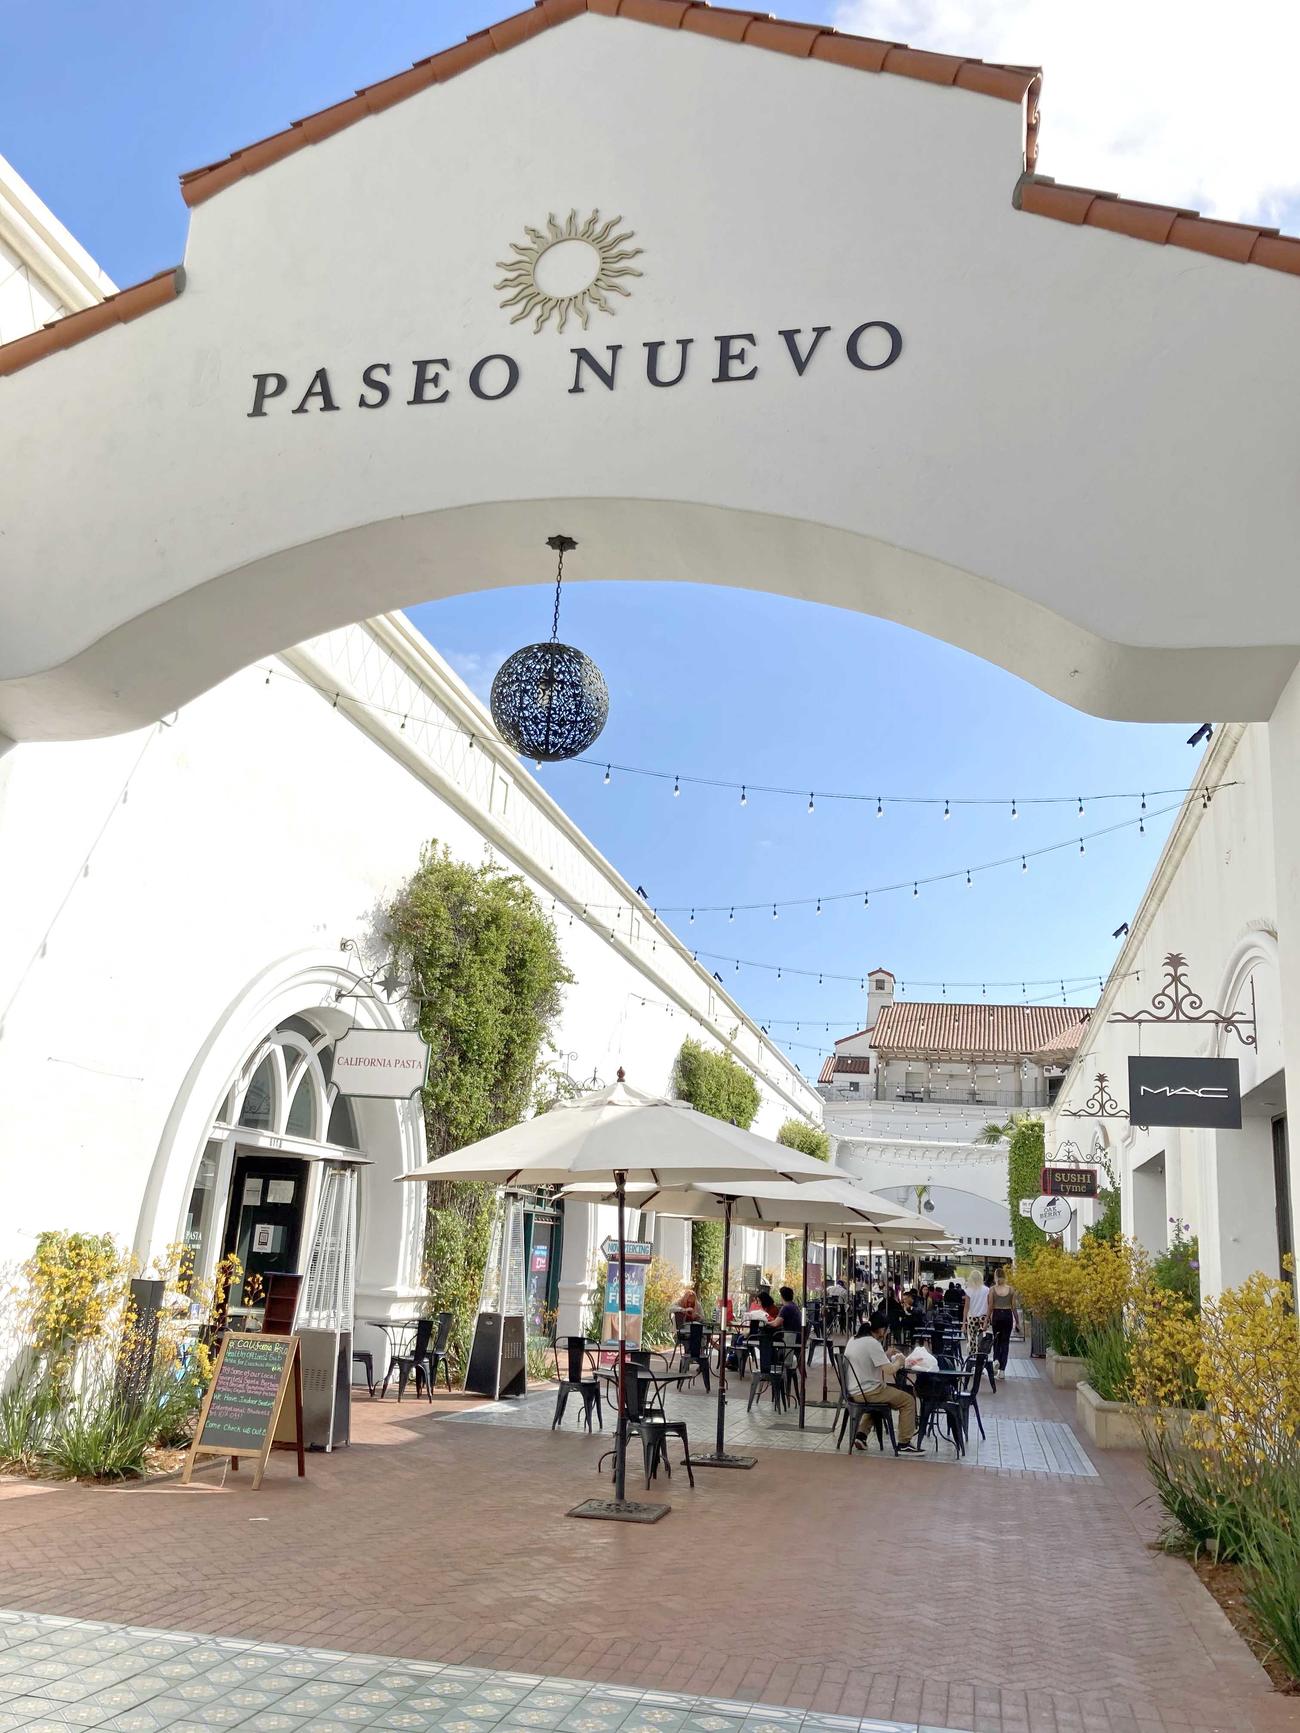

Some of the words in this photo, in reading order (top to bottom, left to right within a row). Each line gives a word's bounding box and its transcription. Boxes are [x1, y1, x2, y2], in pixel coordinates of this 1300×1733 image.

[247, 353, 520, 417] PASEO
[567, 320, 903, 393] NUEVO
[337, 1056, 392, 1068] CALIFORNIA
[394, 1058, 422, 1069] PASTA
[1055, 1172, 1091, 1184] SUSHI
[1040, 1210, 1062, 1219] BERRY
[184, 1231, 202, 1241] PASTA
[608, 1292, 640, 1306] FEE
